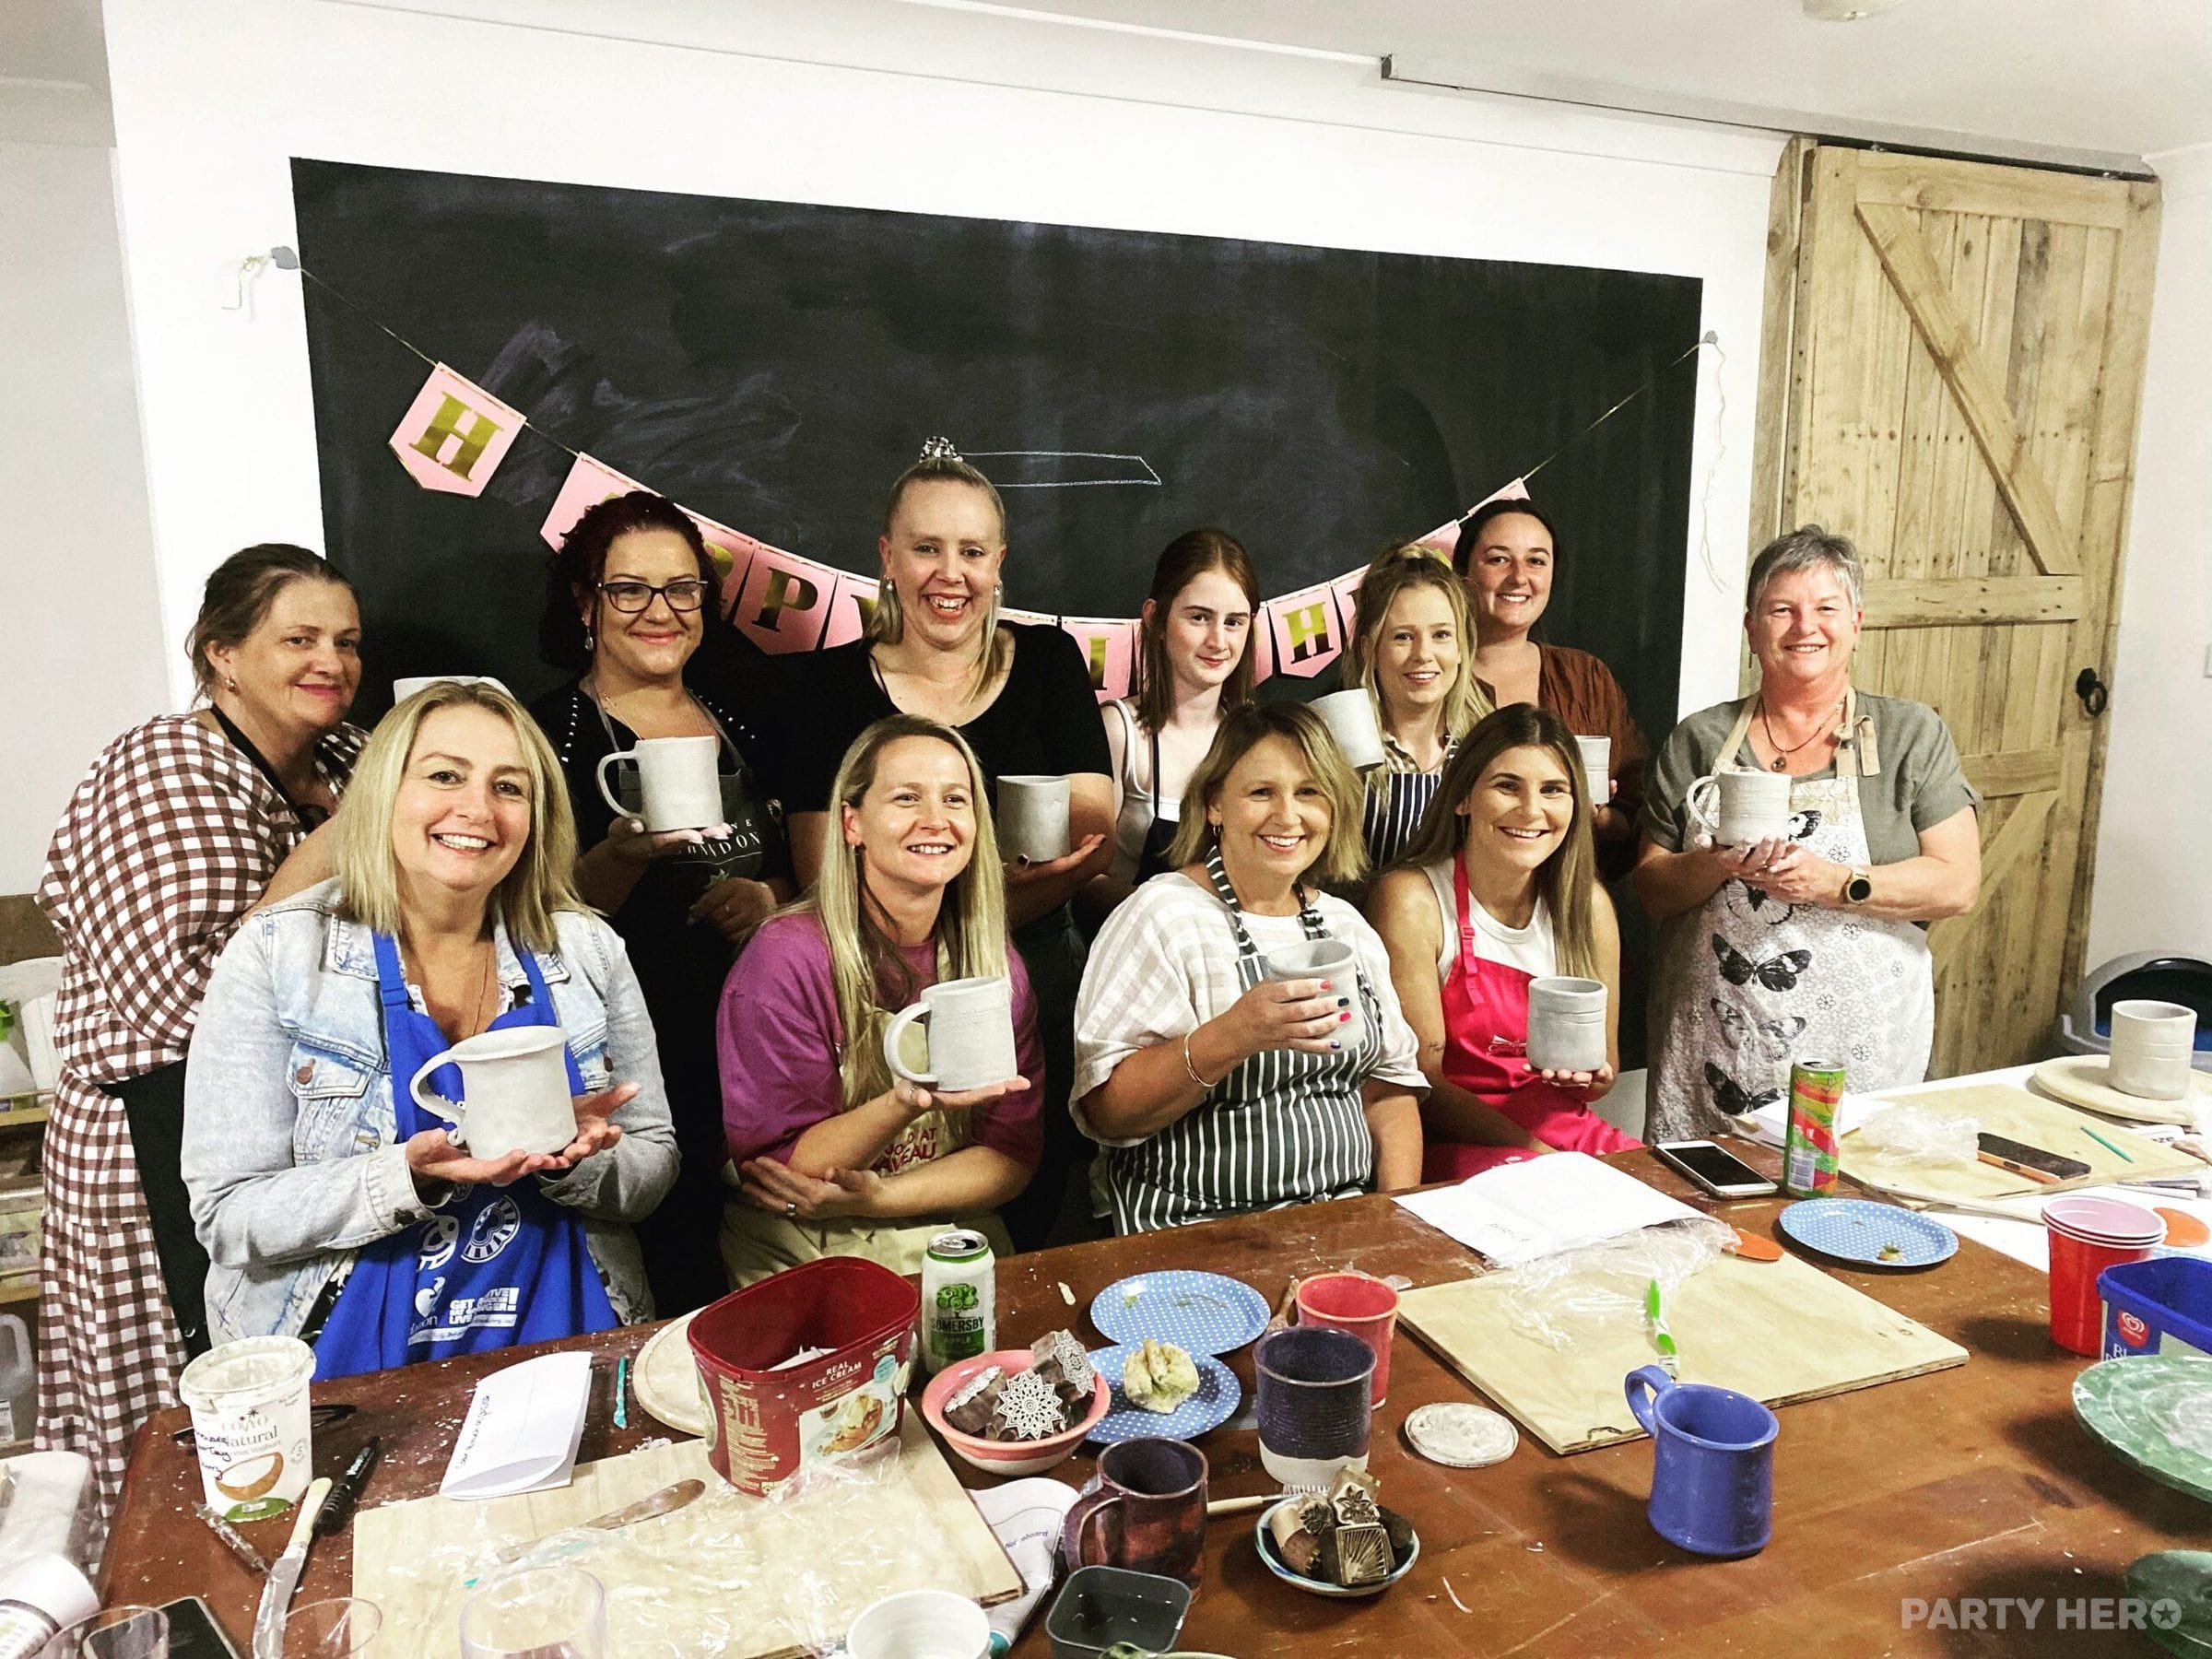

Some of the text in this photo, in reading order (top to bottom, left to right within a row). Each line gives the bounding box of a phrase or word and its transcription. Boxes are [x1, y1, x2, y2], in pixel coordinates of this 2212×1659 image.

[931, 1315, 984, 1333] SOMERSBY
[812, 1377, 828, 1390] ICE
[830, 1361, 863, 1382] CREAM
[826, 1360, 850, 1376] REAL
